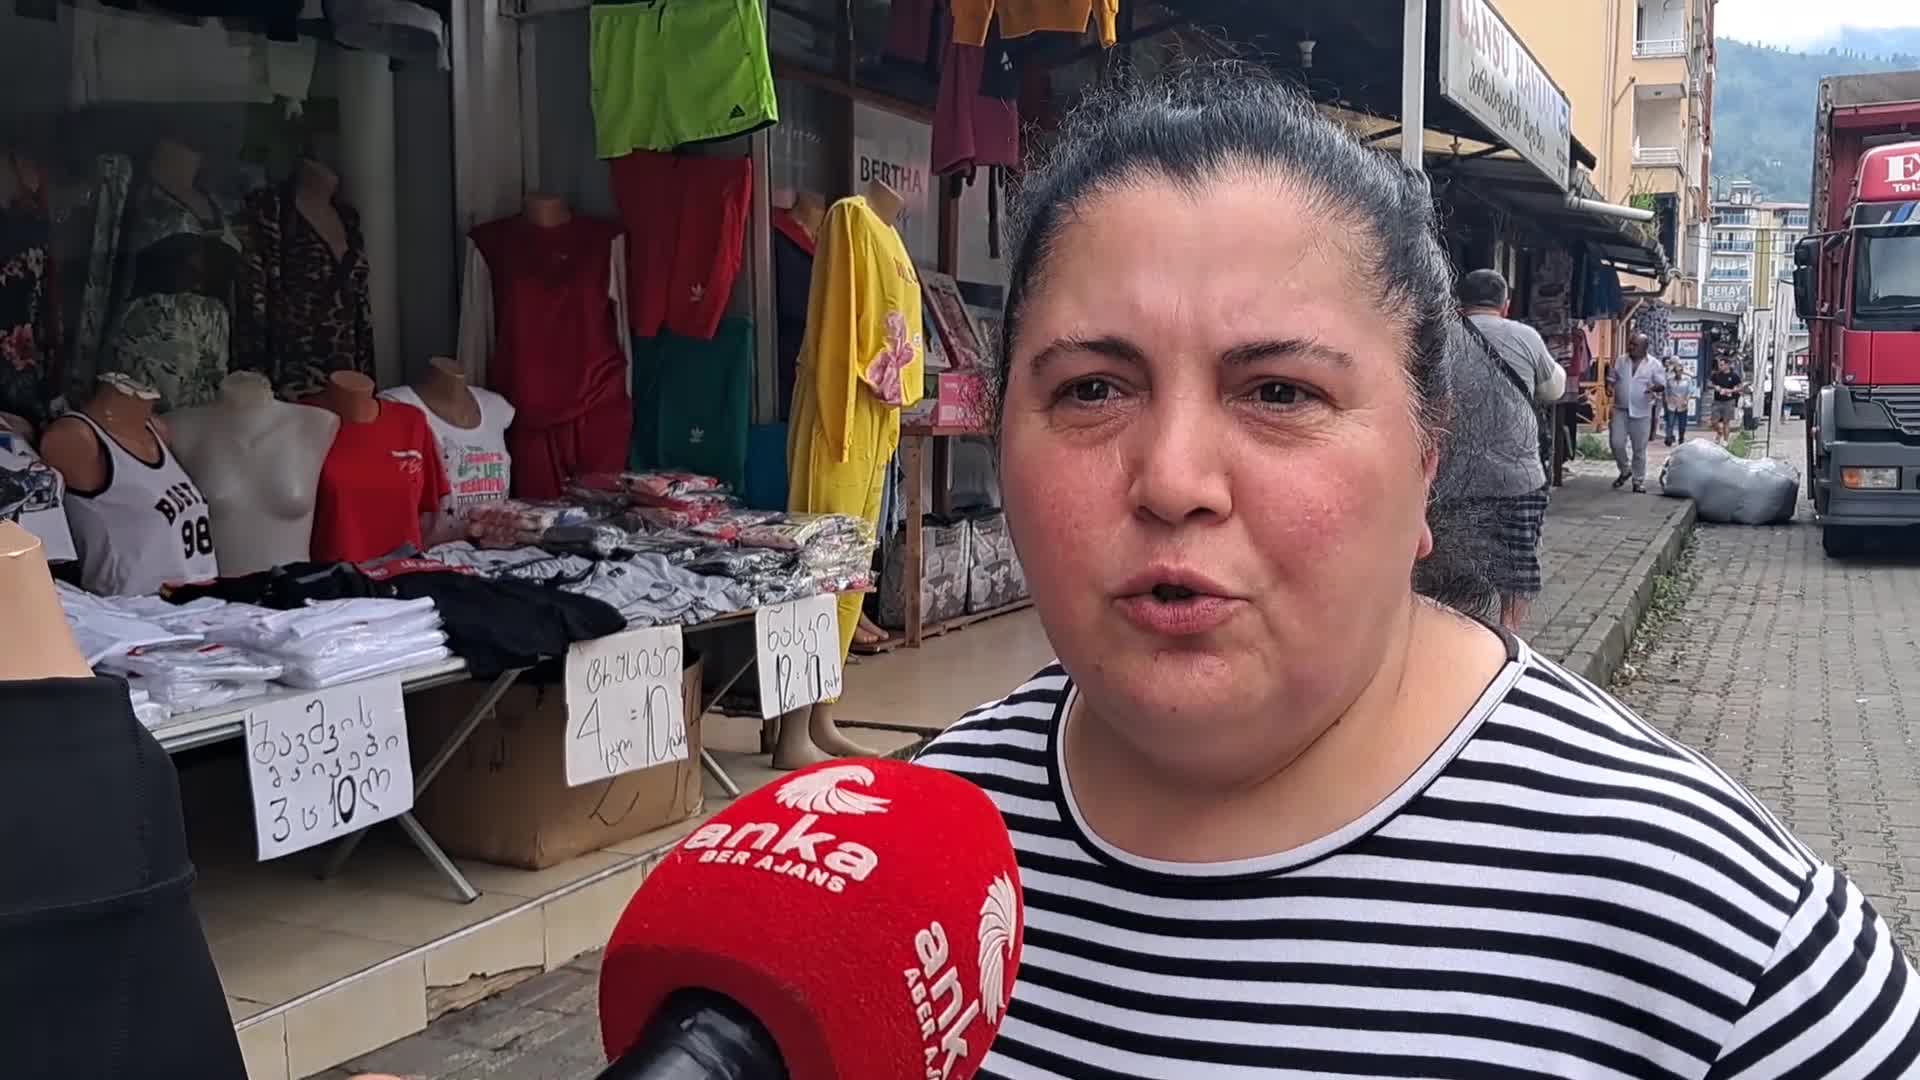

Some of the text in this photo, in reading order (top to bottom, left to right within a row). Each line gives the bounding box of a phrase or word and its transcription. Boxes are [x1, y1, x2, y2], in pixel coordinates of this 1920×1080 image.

[860, 155, 922, 193] BERTHA
[1884, 153, 1920, 182] E
[1707, 286, 1742, 298] BERAY
[1709, 302, 1740, 312] BABY
[182, 515, 213, 559] 98
[577, 697, 603, 760] 4
[684, 813, 878, 882] anka
[753, 855, 847, 894] AJANS
[915, 920, 980, 1080] ank
